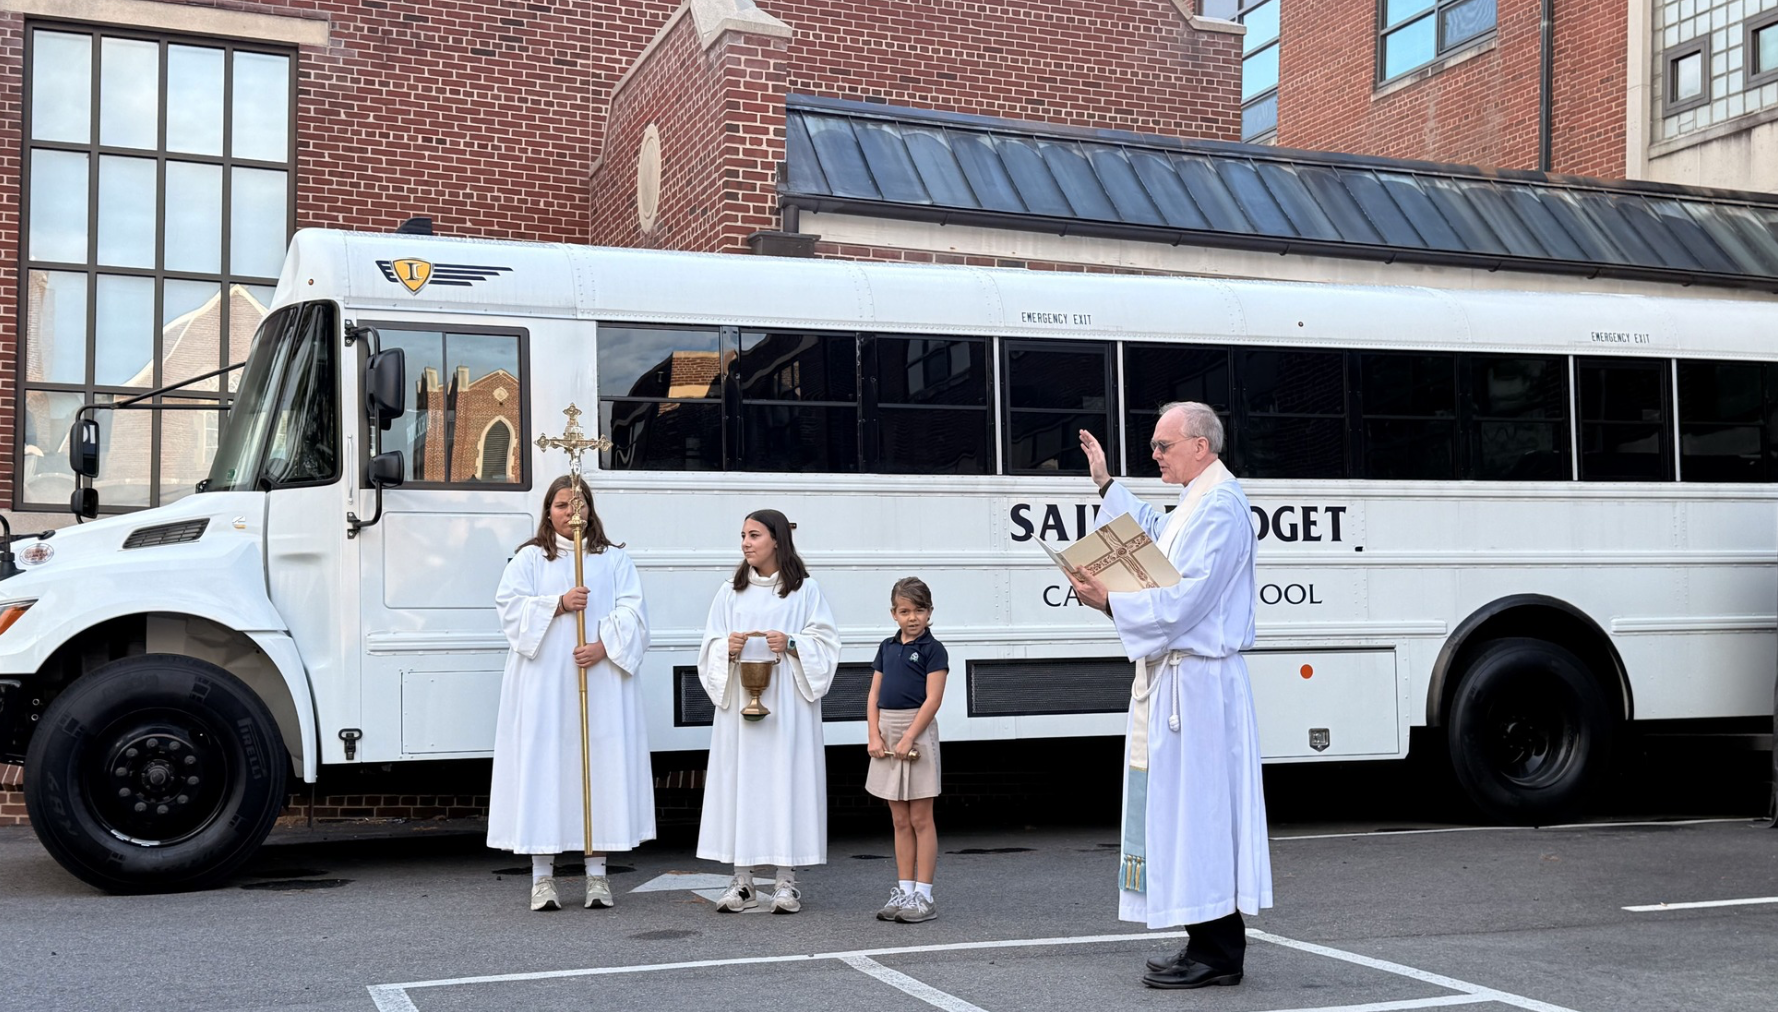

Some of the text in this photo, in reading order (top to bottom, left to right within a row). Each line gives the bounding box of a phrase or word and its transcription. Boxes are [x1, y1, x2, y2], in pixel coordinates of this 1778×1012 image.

[1021, 312, 1091, 325] EMERGENCY EXIT
[1591, 332, 1650, 343] EMERGENCY EXIT
[1010, 503, 1101, 541] SAI
[1260, 584, 1323, 605] OOL
[237, 717, 268, 780] PIRELLI
